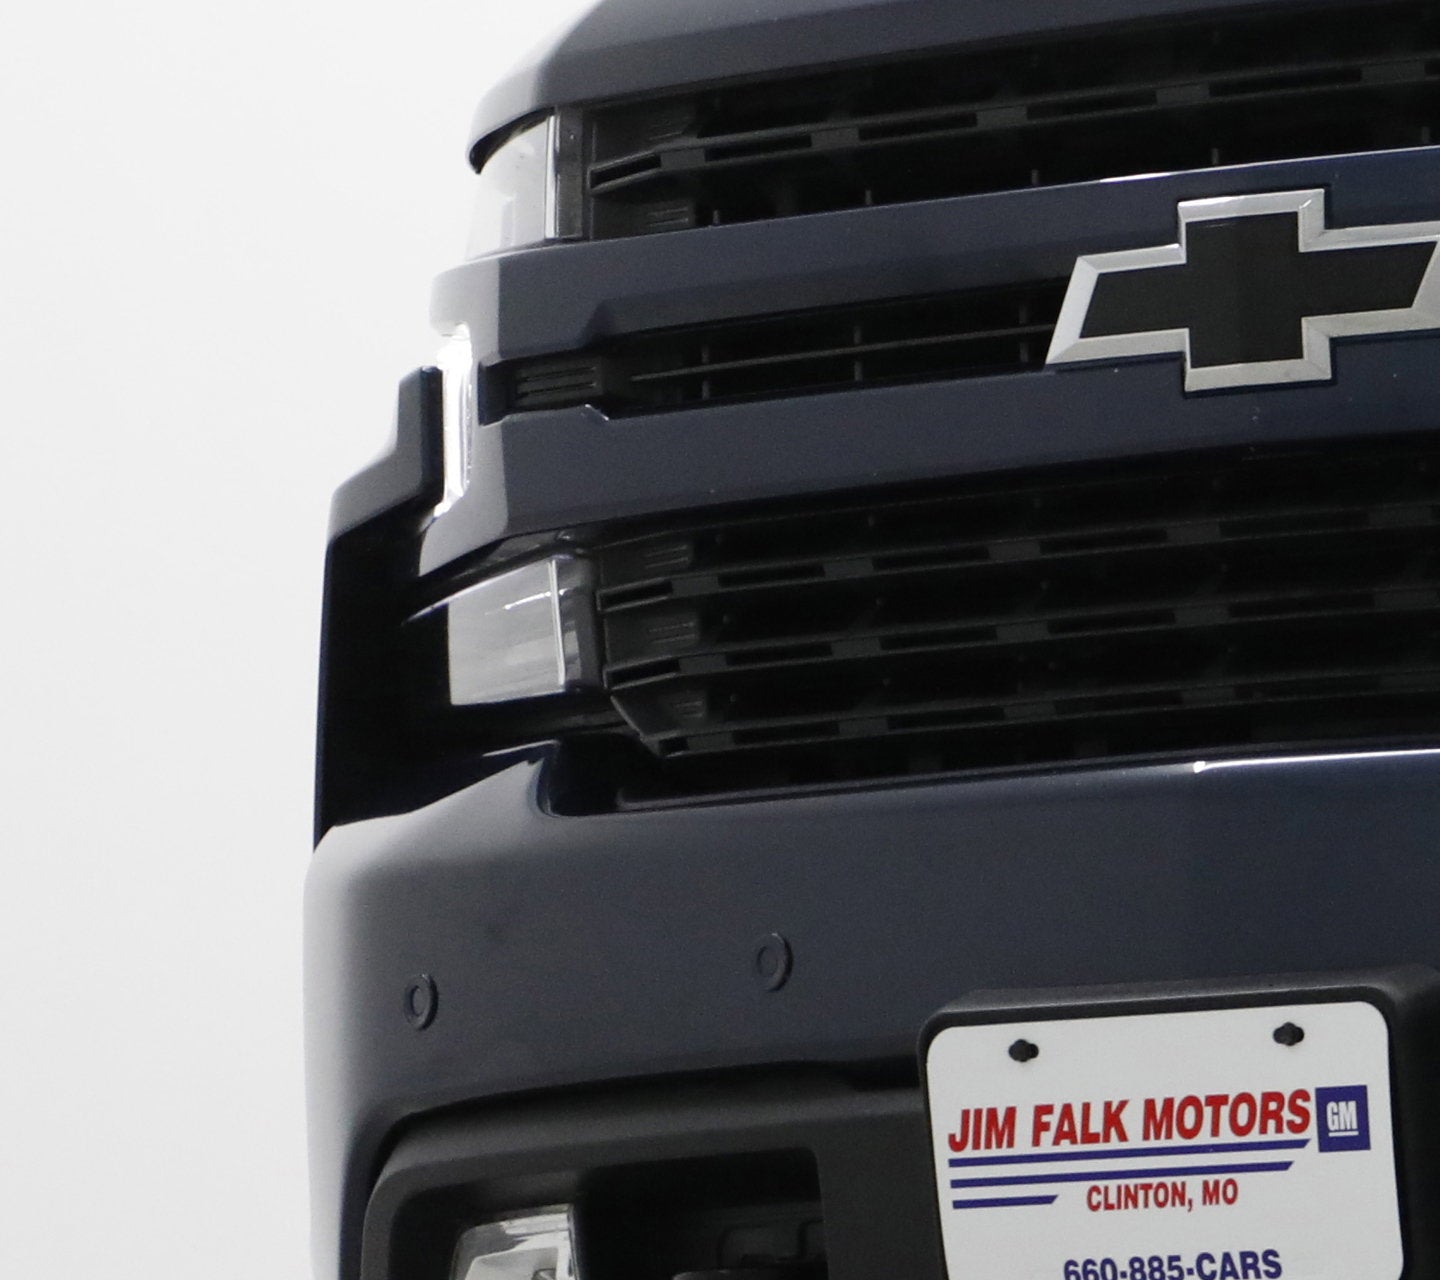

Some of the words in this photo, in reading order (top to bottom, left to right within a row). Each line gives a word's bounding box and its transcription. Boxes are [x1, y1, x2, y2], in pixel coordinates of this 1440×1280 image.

[948, 1106, 1017, 1153] JIM
[1032, 1099, 1129, 1148] FALK
[1142, 1089, 1312, 1142] MOTORS
[1325, 1099, 1359, 1133] GM
[1087, 1181, 1194, 1213] CLINTON,
[1202, 1178, 1239, 1206] MO
